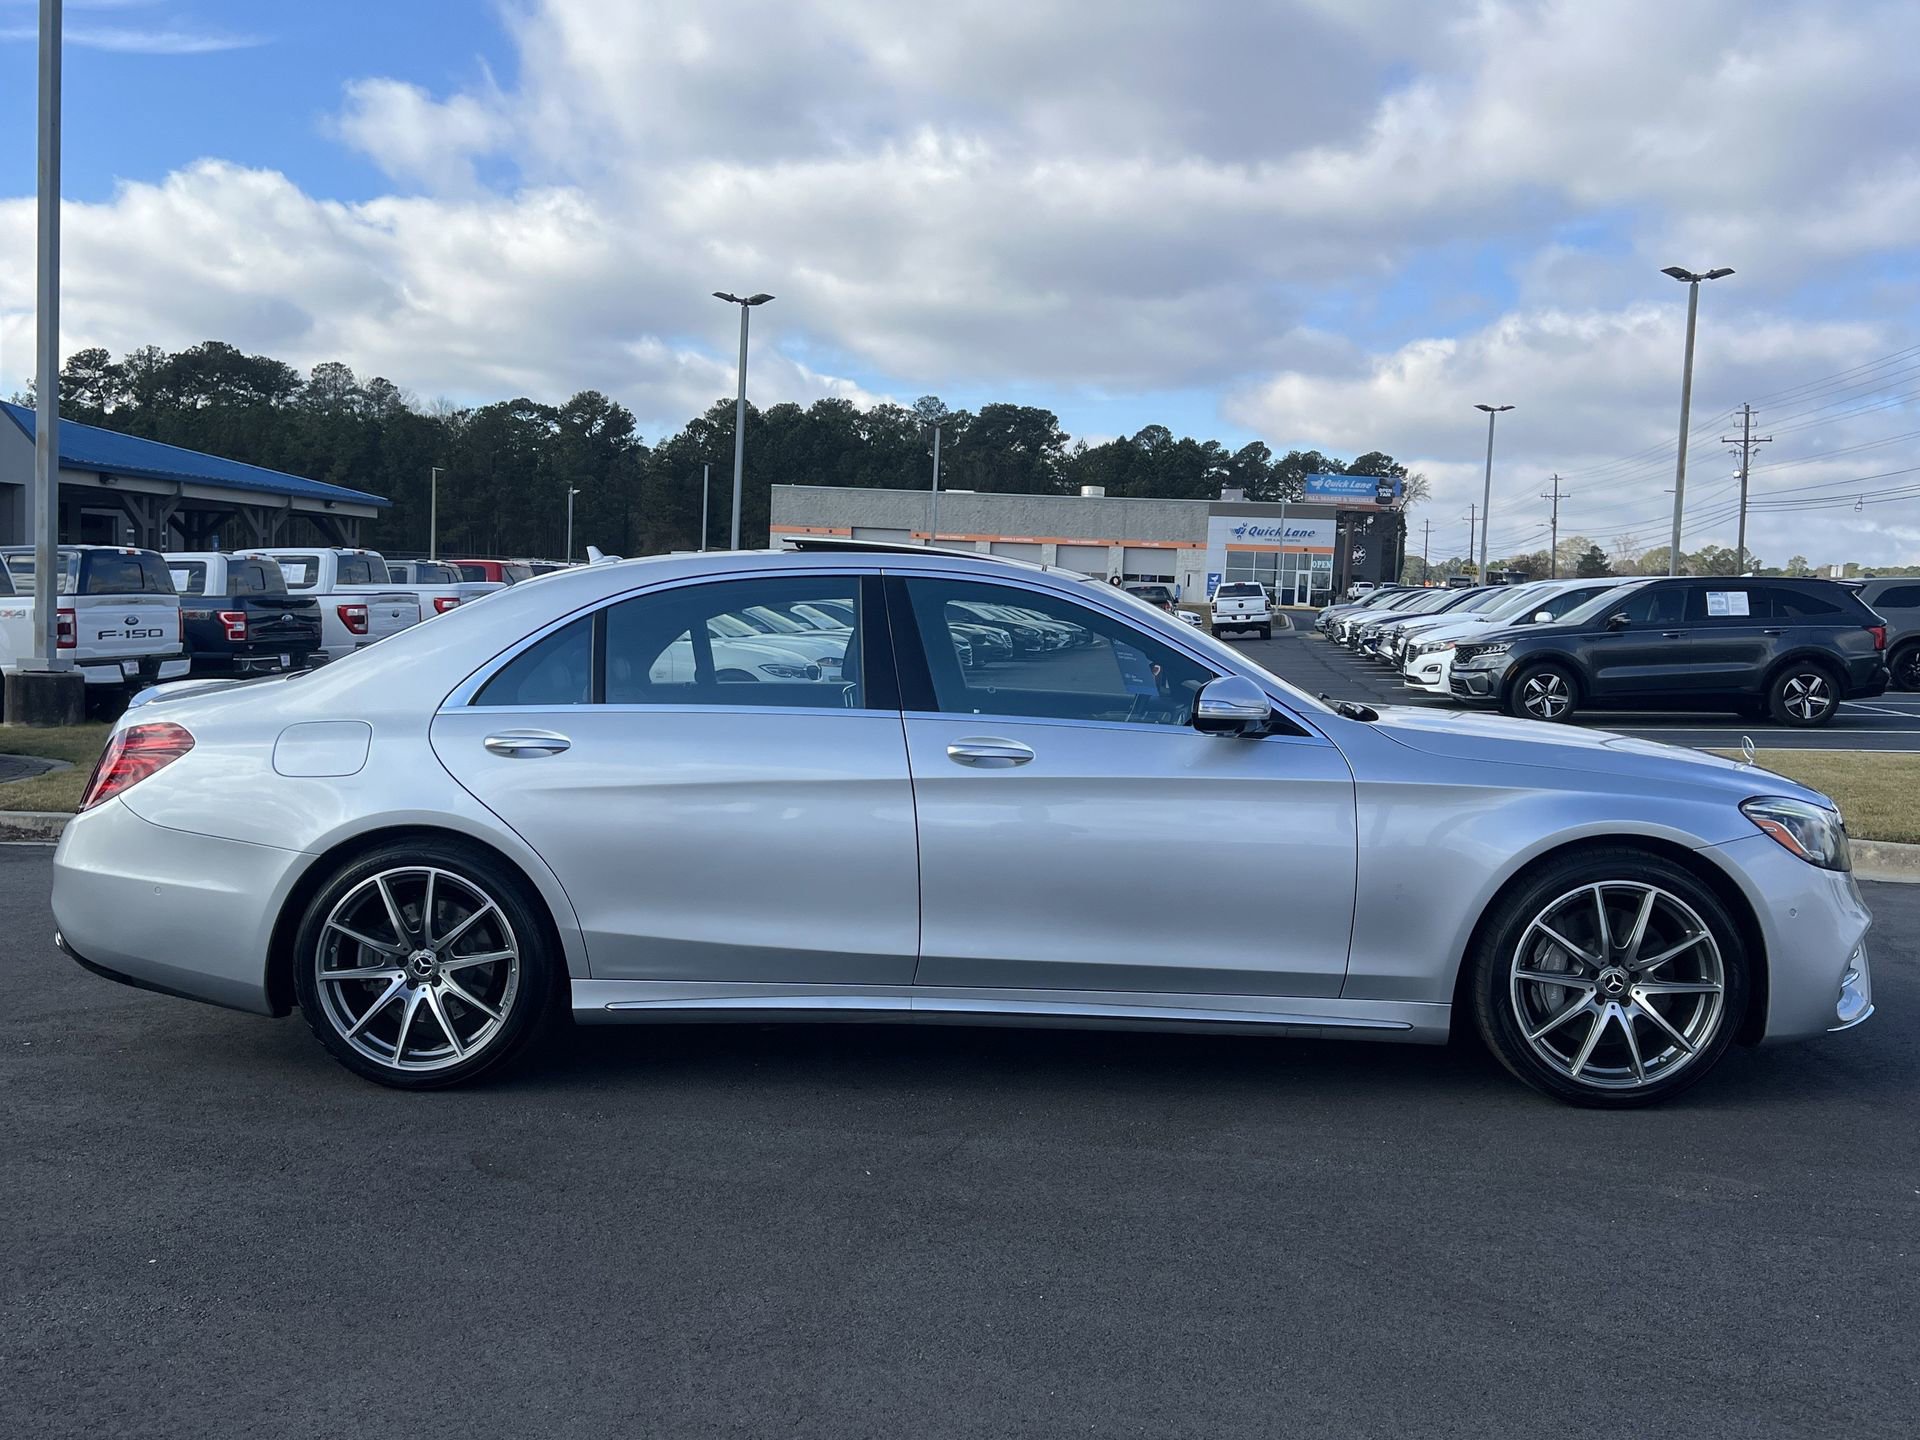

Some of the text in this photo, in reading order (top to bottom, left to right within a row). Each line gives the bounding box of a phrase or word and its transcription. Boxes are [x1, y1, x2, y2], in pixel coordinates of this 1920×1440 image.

[1324, 479, 1372, 489] Quick Lane
[1248, 526, 1316, 537] Quick Lane
[1312, 560, 1331, 568] OPEN
[0, 609, 26, 617] X4
[98, 628, 163, 640] F-150
